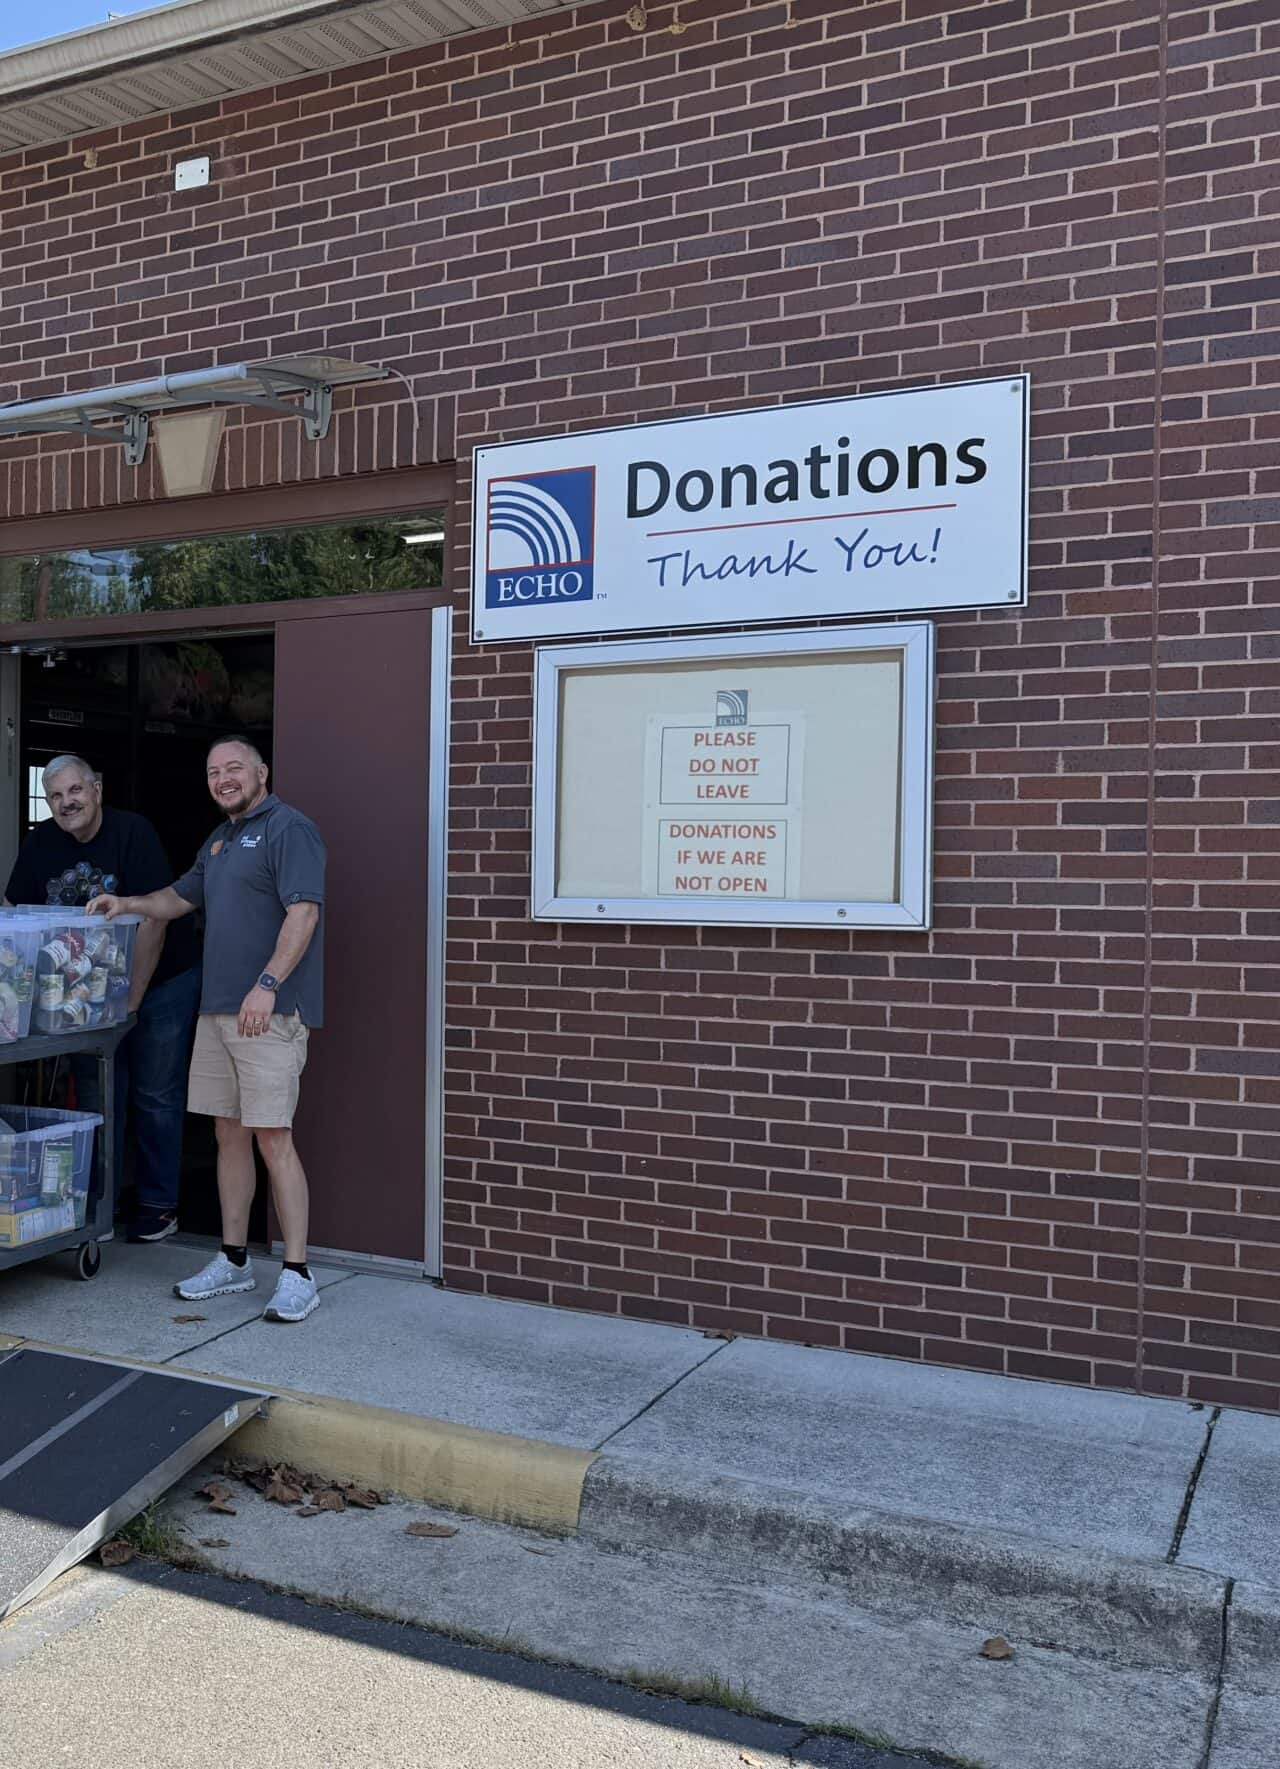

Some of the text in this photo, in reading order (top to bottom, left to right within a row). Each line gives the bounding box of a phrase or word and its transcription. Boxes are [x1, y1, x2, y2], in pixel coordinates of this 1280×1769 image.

[626, 436, 987, 519] Donations
[647, 528, 942, 587] Thank You!
[497, 571, 583, 602] ECHO
[693, 732, 757, 747] PLEASE
[689, 758, 760, 773] DO NOT
[696, 784, 750, 799] LEAVE
[670, 824, 777, 840] DONATIONS
[677, 849, 767, 866] IF WE ARE
[675, 876, 768, 892] NOT OPEN
